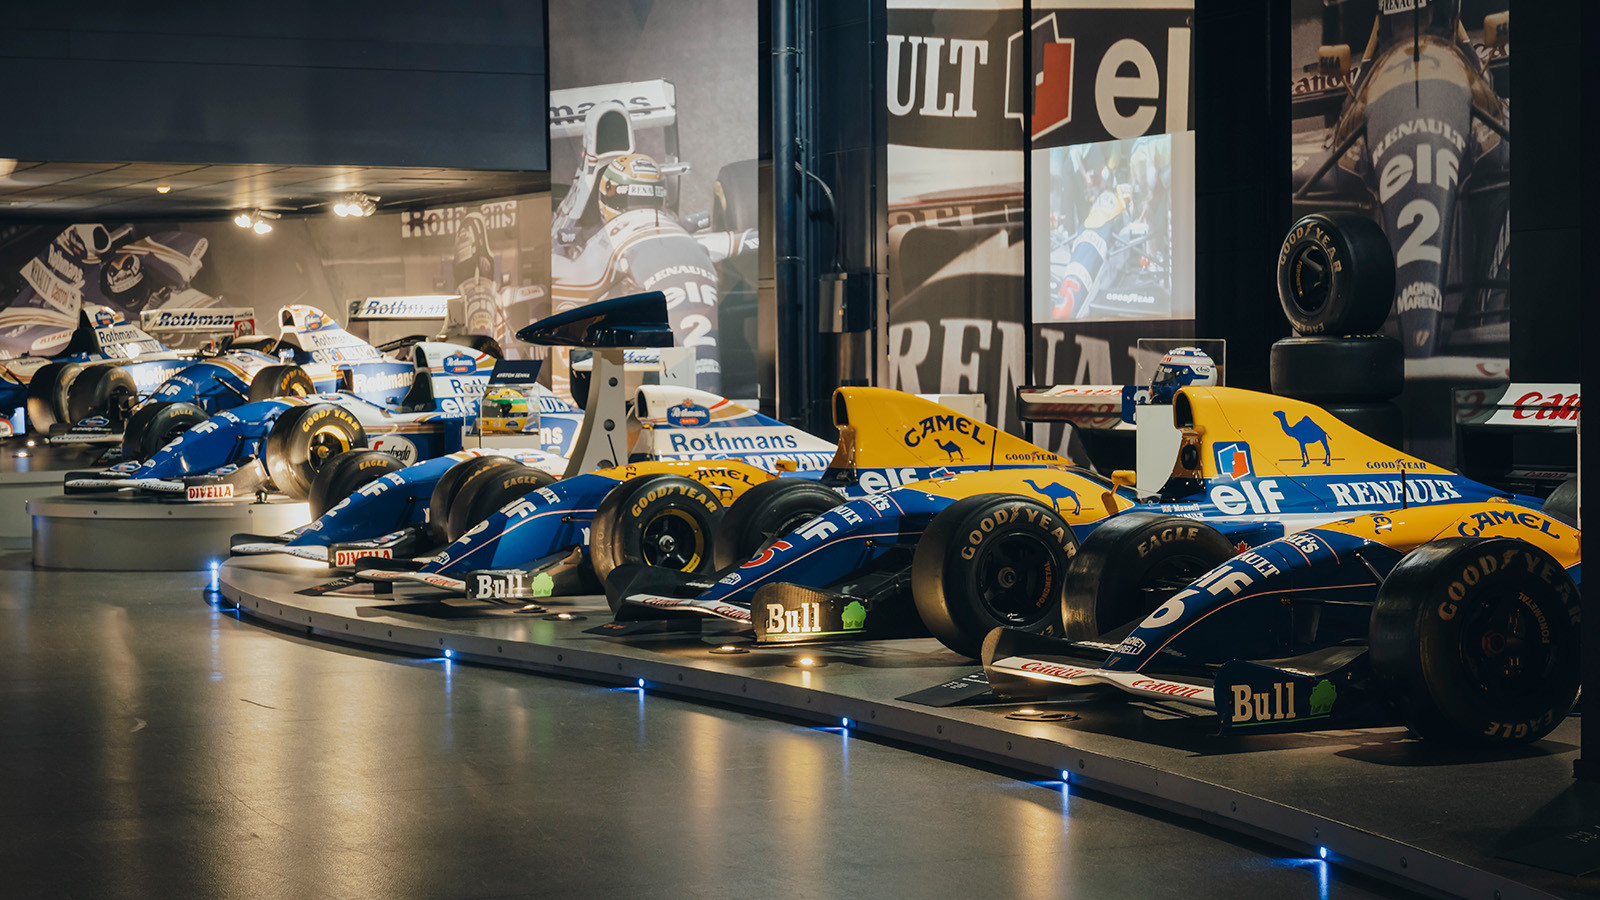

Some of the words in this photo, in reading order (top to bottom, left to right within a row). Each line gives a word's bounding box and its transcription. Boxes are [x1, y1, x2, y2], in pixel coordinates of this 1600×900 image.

[1372, 118, 1466, 165] RENAULT
[1379, 144, 1459, 202] elf
[1397, 199, 1440, 268] 2
[643, 264, 719, 291] RENAULT
[98, 326, 138, 343] Rothmans
[680, 314, 717, 347] 2
[302, 408, 360, 433] GOODYEAR
[904, 415, 985, 447] CAMEL
[671, 432, 798, 452] Rothmans
[1005, 453, 1058, 462] GOODYEAR
[359, 460, 388, 470] EAGLE
[1366, 459, 1427, 470] GOODYEAR
[189, 487, 232, 499] DIVELLA
[504, 476, 538, 489] EAGLE
[1210, 480, 1285, 515] elf
[1327, 479, 1462, 507] RENAULT
[632, 486, 718, 518] GOODYEAR
[961, 503, 1078, 560] GOODYEAR
[1457, 510, 1561, 540] CAMEL
[739, 540, 794, 569] 5
[1137, 526, 1199, 558] EAGLE
[476, 574, 524, 599] Bull
[1036, 561, 1052, 608] FONDMETAL
[1438, 551, 1582, 626] GOODYEAR
[766, 602, 823, 634] Bull
[1138, 588, 1200, 630] 6
[1518, 591, 1551, 644] FONDMETAL
[1020, 661, 1086, 679] Canon
[1131, 679, 1205, 698] Canon
[1231, 681, 1297, 723] Bull
[1484, 708, 1554, 739] EAGLE
